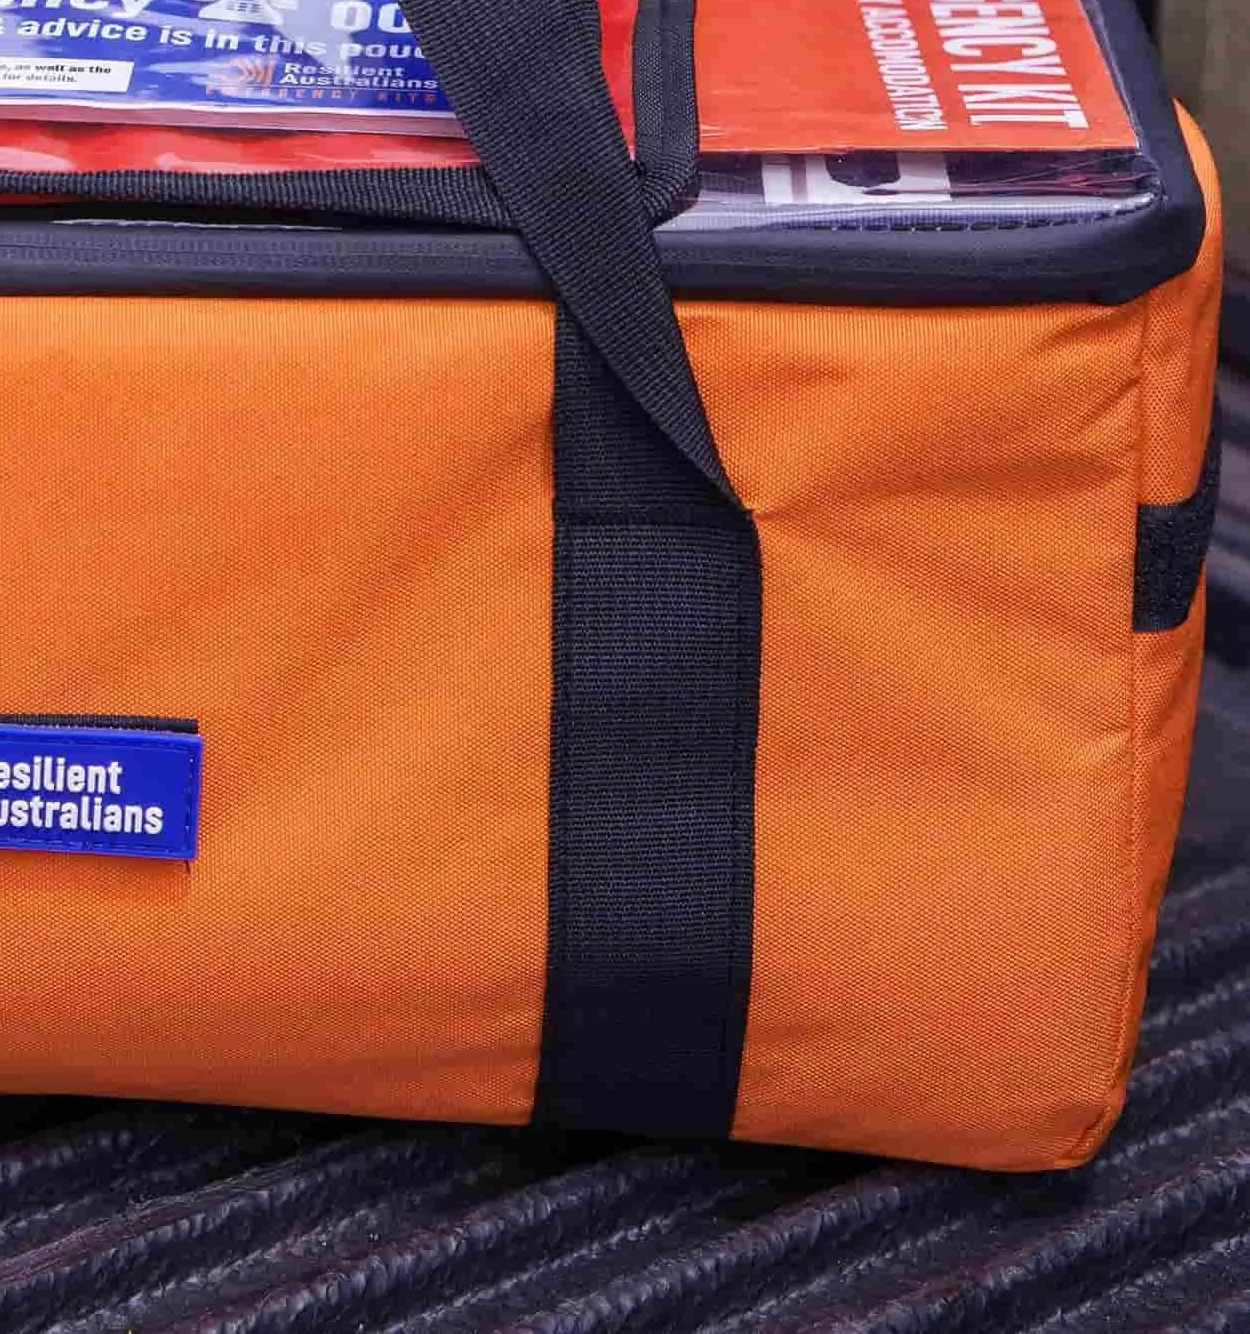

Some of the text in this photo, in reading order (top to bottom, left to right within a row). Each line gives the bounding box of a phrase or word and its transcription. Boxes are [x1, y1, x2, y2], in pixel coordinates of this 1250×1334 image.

[18, 17, 148, 42] advice
[158, 24, 191, 46] is
[205, 26, 239, 50] in
[254, 34, 327, 56] this
[278, 73, 439, 90] Australians
[957, 83, 1089, 129] KIT
